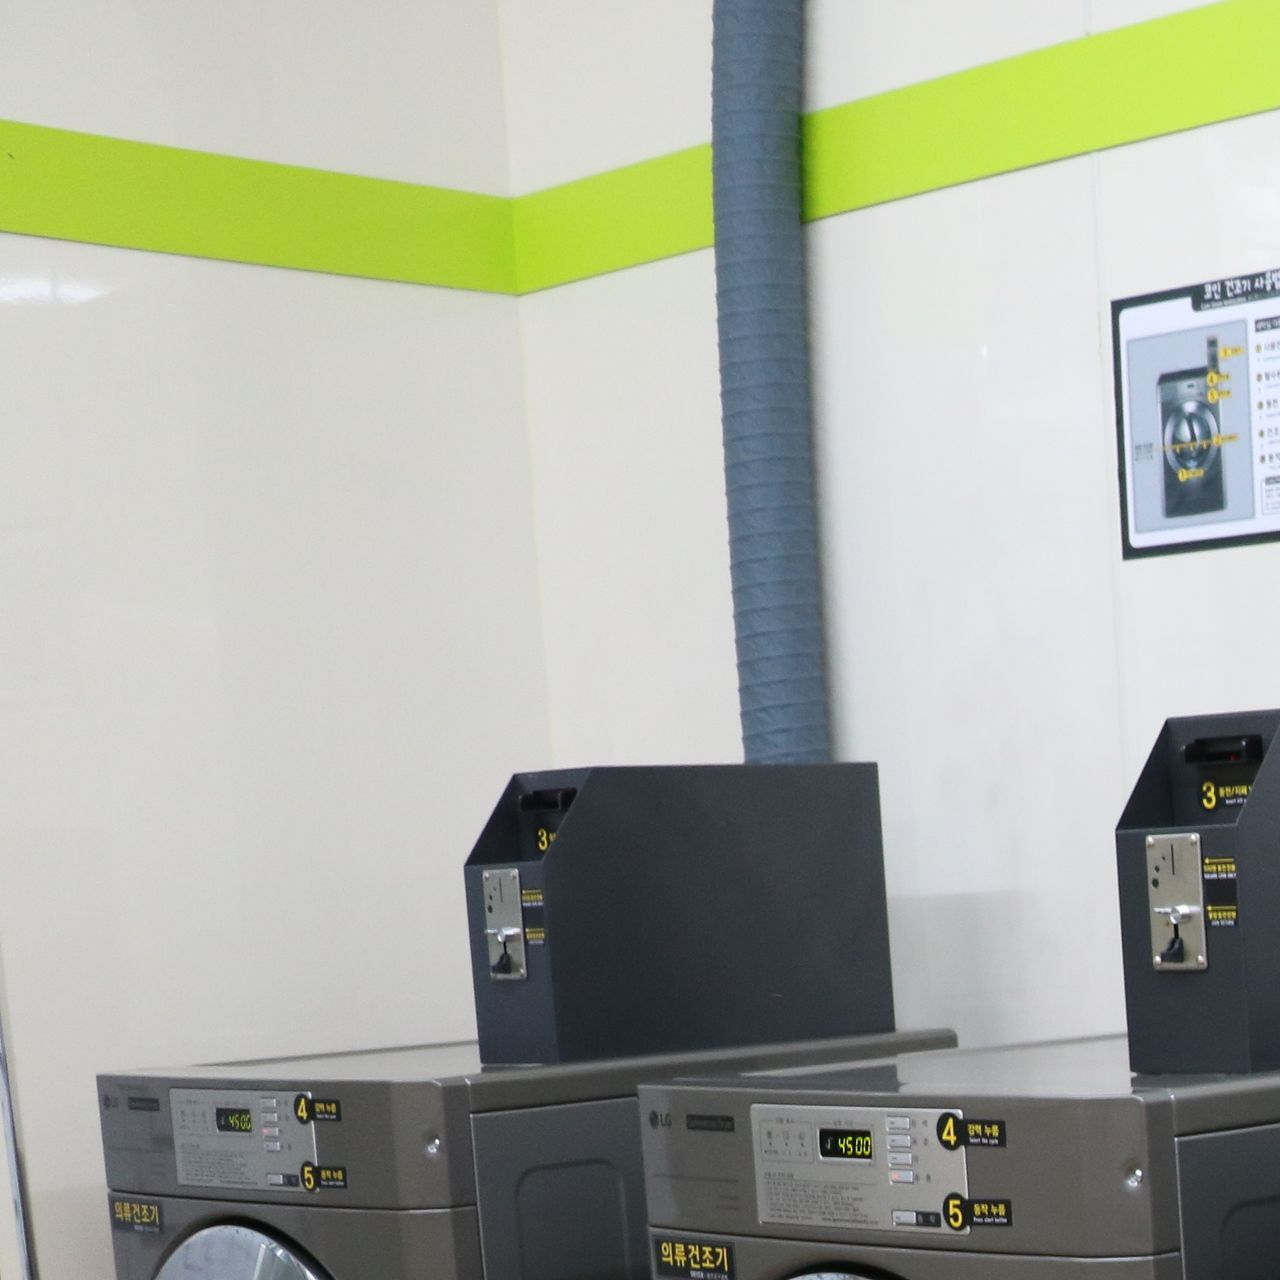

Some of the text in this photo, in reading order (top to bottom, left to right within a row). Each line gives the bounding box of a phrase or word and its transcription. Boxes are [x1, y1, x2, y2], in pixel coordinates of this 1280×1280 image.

[1202, 782, 1216, 810] 3
[538, 829, 547, 850] 3
[297, 1099, 307, 1120] 4
[942, 1117, 956, 1145] 4
[838, 1137, 871, 1155] 4500
[304, 1167, 314, 1188] 5
[949, 1200, 962, 1228] 5
[661, 1242, 729, 1272] 의류건조기
